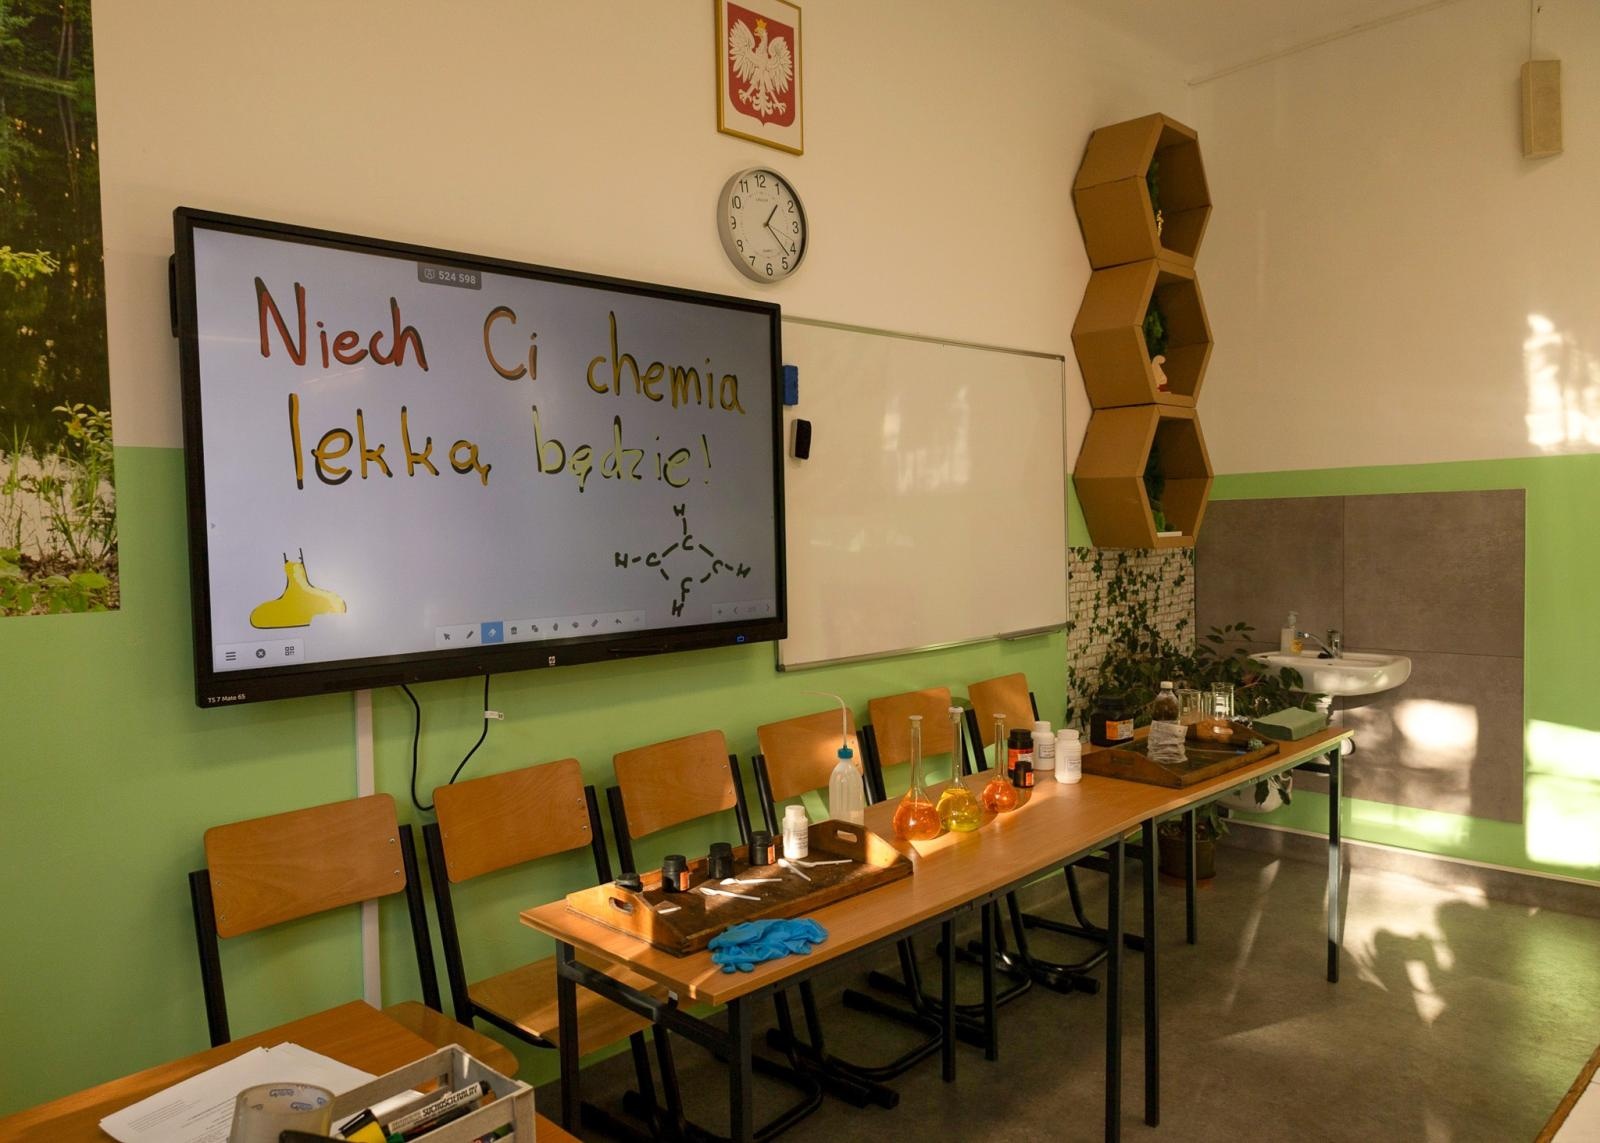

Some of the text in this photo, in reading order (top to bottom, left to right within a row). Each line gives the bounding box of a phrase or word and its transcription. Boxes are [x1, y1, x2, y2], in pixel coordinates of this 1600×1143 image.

[739, 180, 748, 192] 11
[754, 174, 766, 188] 12
[775, 183, 780, 195] 1
[732, 196, 741, 209] 10
[788, 201, 794, 213] 2
[731, 216, 736, 229] 9
[792, 221, 799, 234] 3
[737, 240, 743, 252] 8
[790, 242, 796, 254] 4
[749, 256, 755, 266] 7
[782, 257, 788, 269] 5
[766, 263, 773, 276] 6
[438, 271, 476, 284] 524 598
[255, 276, 745, 414] Niech Ci chemia
[289, 393, 712, 493] lekką będzie!
